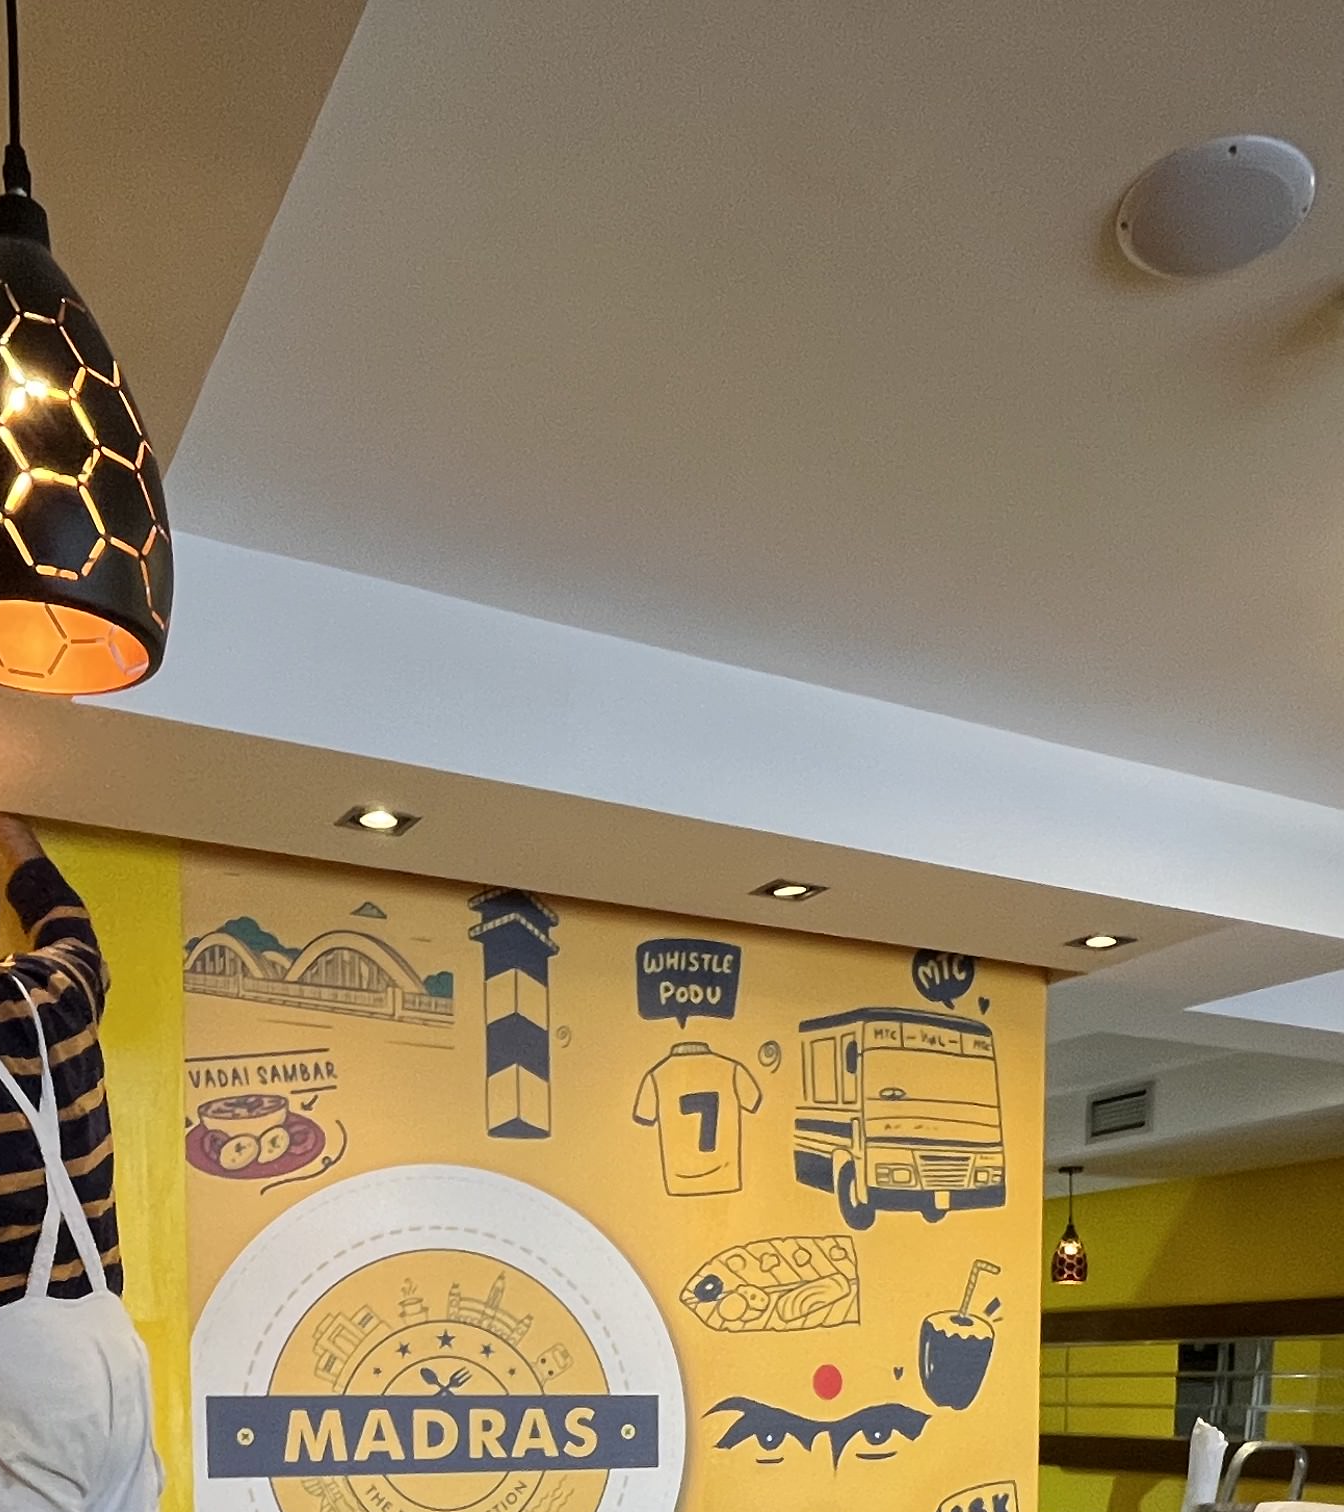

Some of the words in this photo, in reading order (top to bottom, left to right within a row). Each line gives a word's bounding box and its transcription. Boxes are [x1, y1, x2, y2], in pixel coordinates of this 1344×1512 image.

[642, 951, 734, 974] WHISTLE
[918, 954, 967, 989] MTC
[874, 1028, 897, 1041] MTC
[188, 1066, 250, 1088] VADAI
[256, 1061, 338, 1086] SAMBAR
[679, 1091, 719, 1152] 7
[283, 1407, 599, 1463] MADRAS
[364, 1484, 391, 1512] THE
